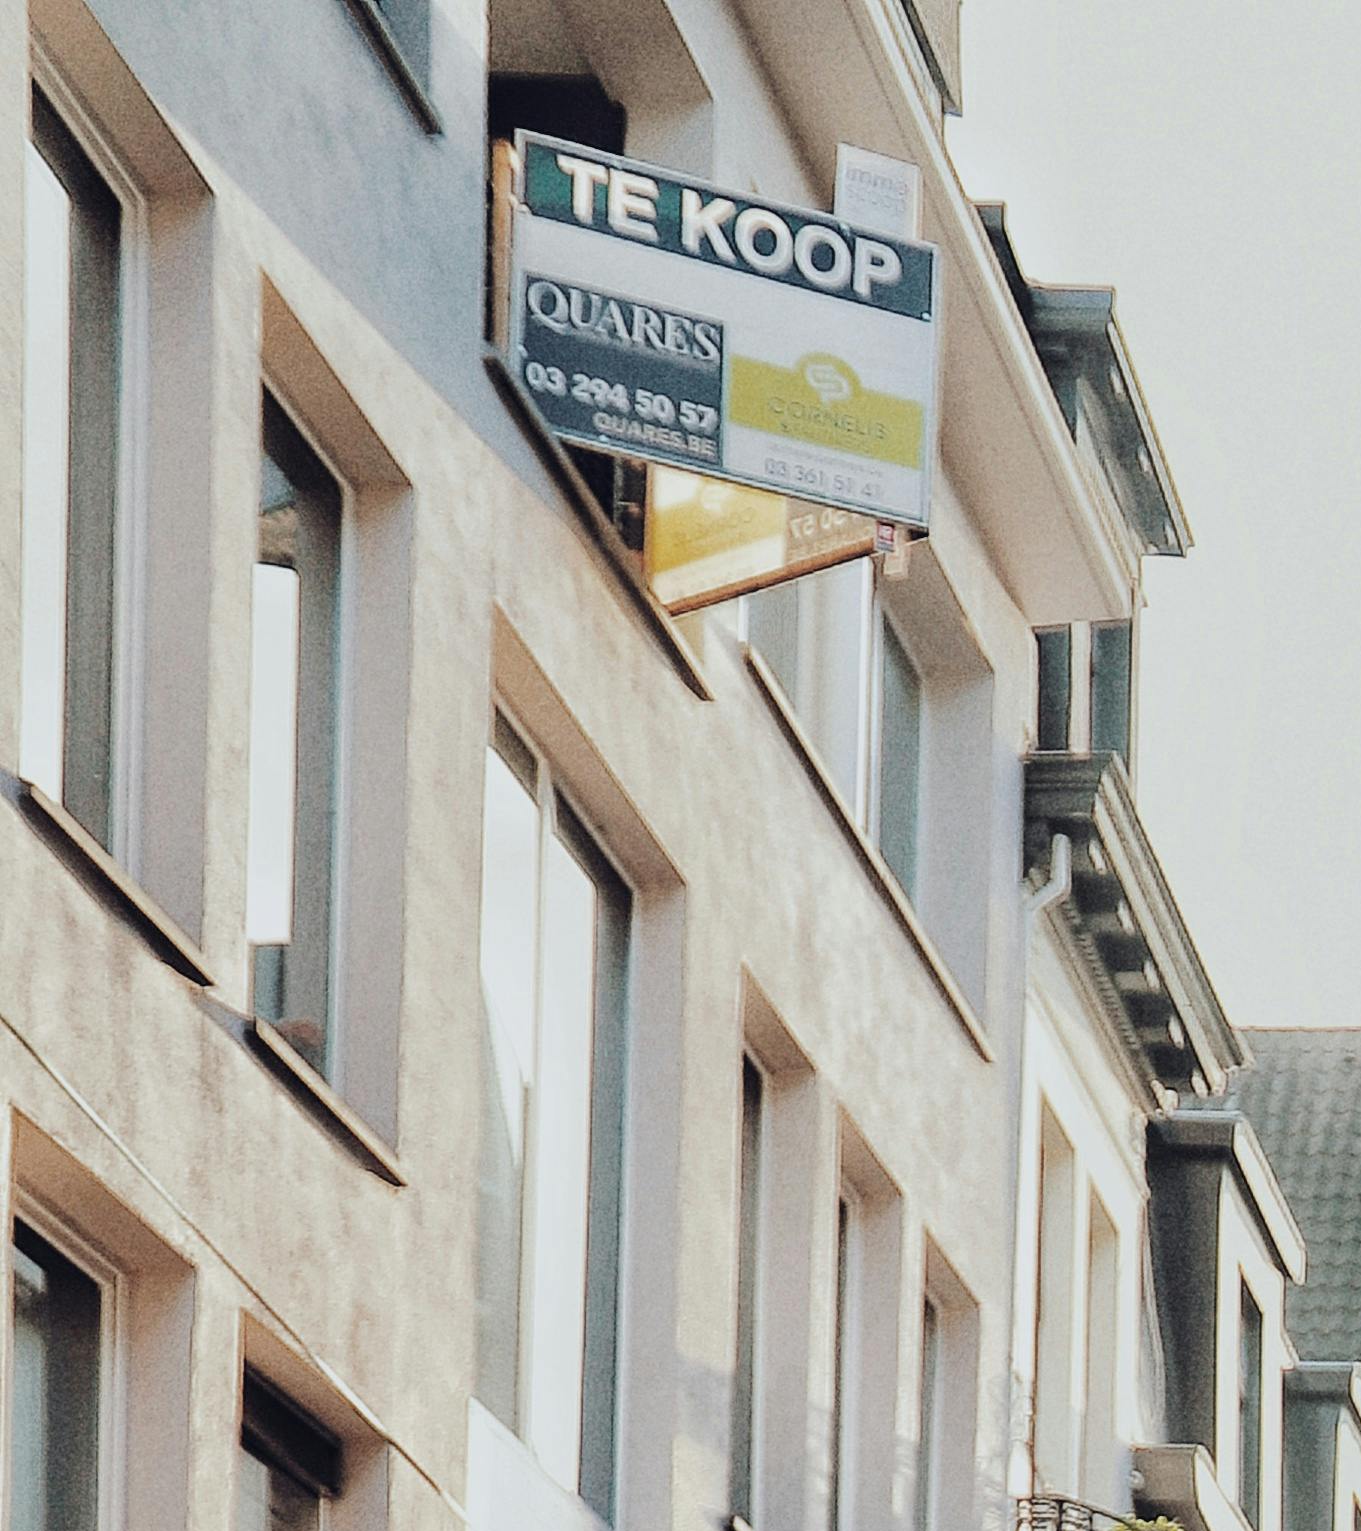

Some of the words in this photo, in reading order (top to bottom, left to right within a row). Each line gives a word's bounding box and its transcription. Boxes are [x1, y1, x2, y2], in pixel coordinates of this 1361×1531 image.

[556, 154, 660, 245] TE
[681, 189, 903, 298] KOOP
[527, 281, 721, 362] QUARES
[525, 361, 567, 397] 03
[571, 373, 632, 413] 294
[635, 388, 676, 425] 50
[679, 399, 720, 436] 57
[593, 412, 718, 458] QUARES.BE
[794, 464, 825, 486] 361
